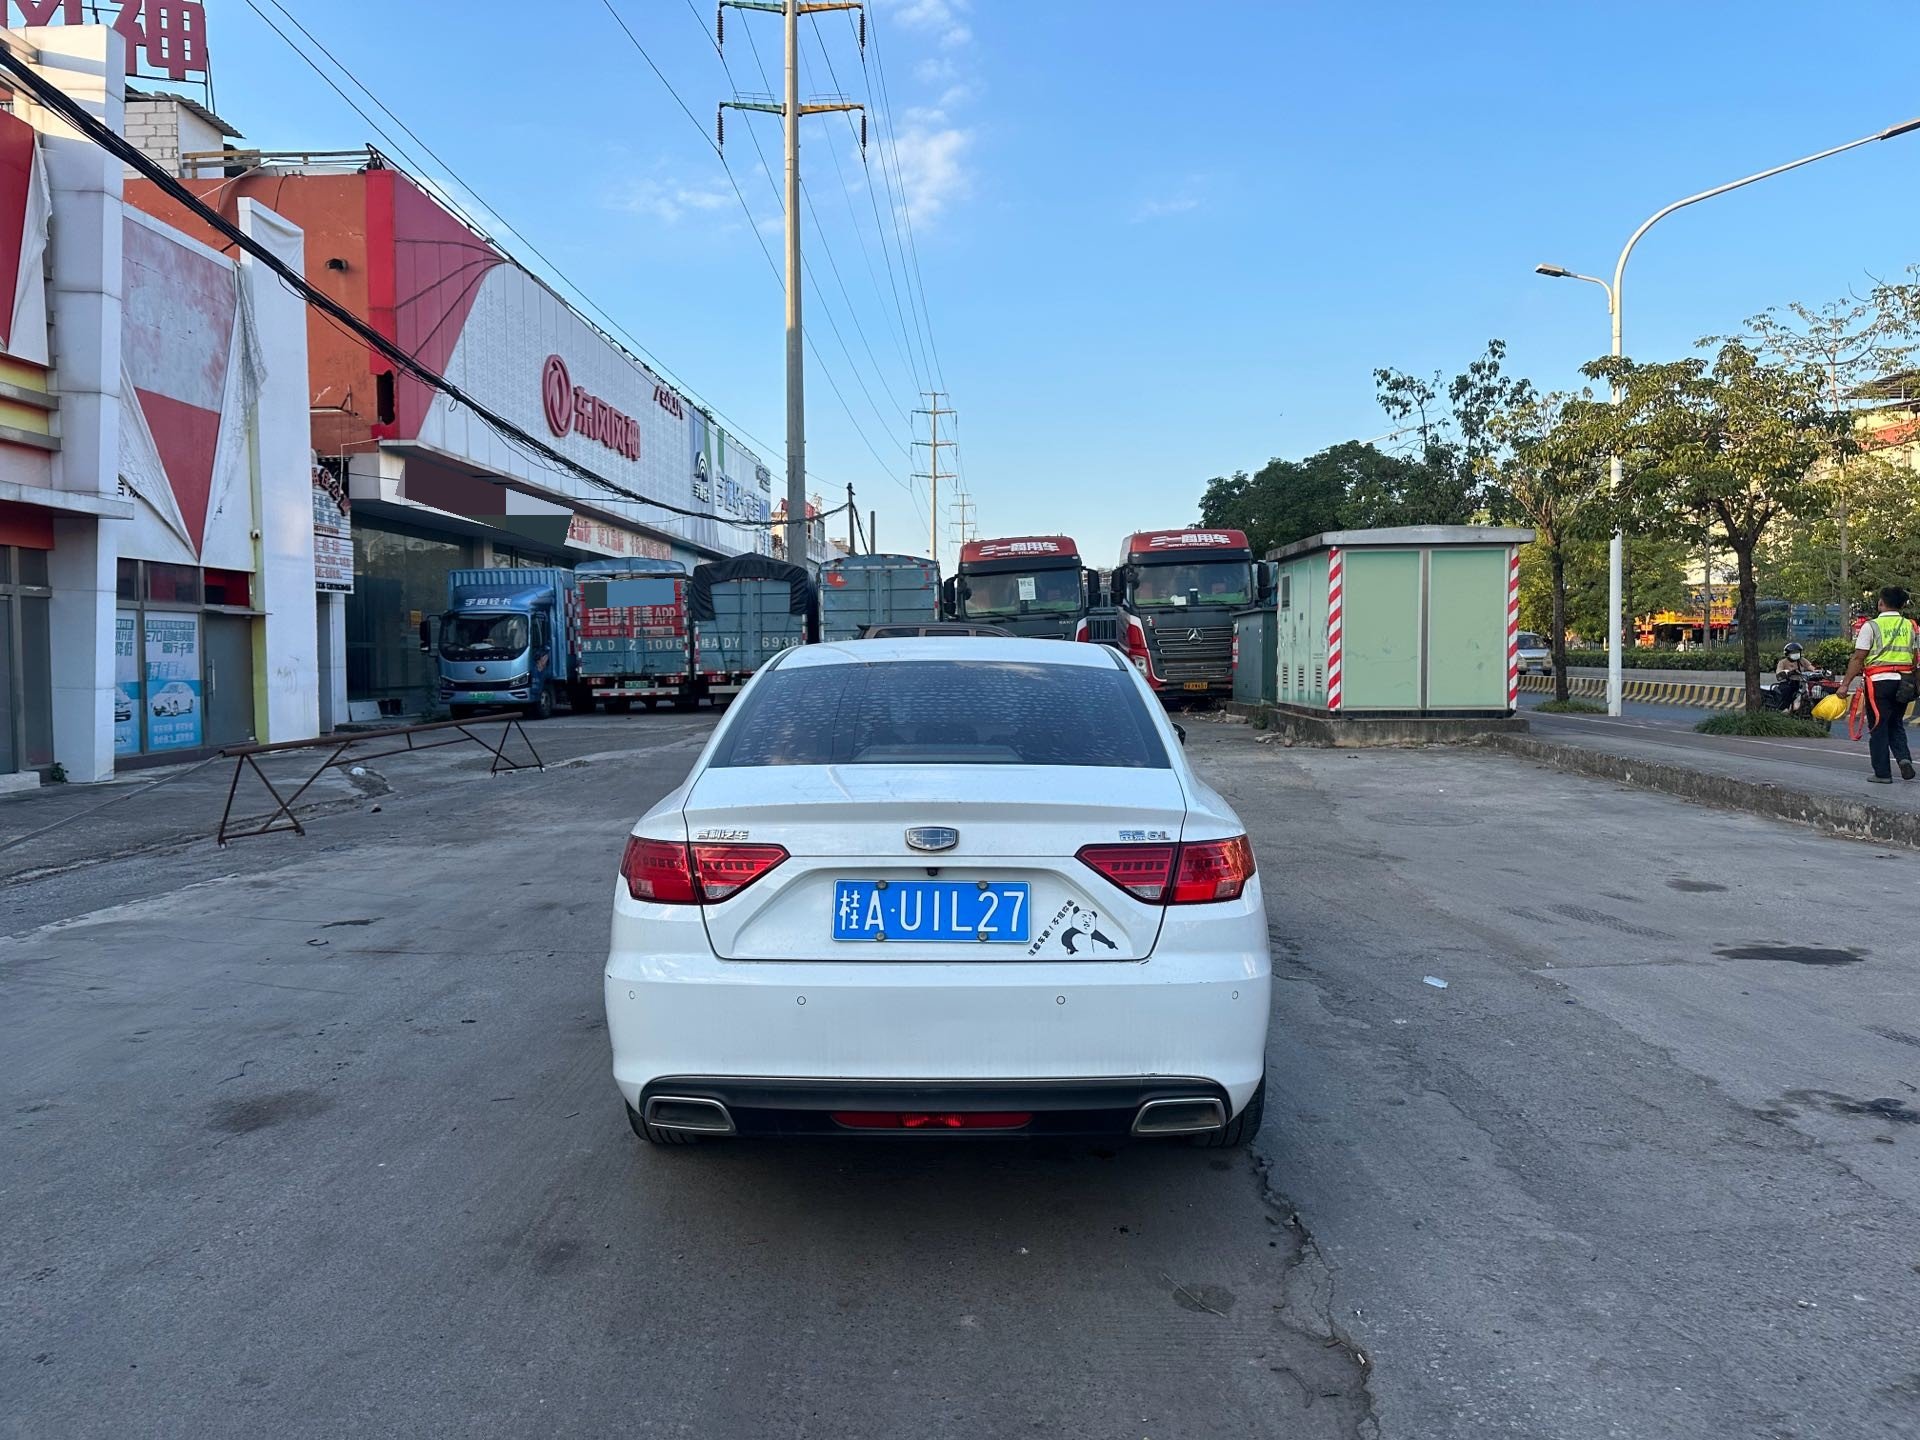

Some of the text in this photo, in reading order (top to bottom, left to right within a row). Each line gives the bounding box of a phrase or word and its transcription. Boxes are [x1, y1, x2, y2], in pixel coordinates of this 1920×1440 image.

[573, 386, 641, 461] 东风风神
[1149, 533, 1231, 547] 三一商用车
[979, 541, 1060, 556] 三一商用车
[464, 597, 513, 607] 宇通轻卡
[696, 829, 749, 841] 吉利汽车
